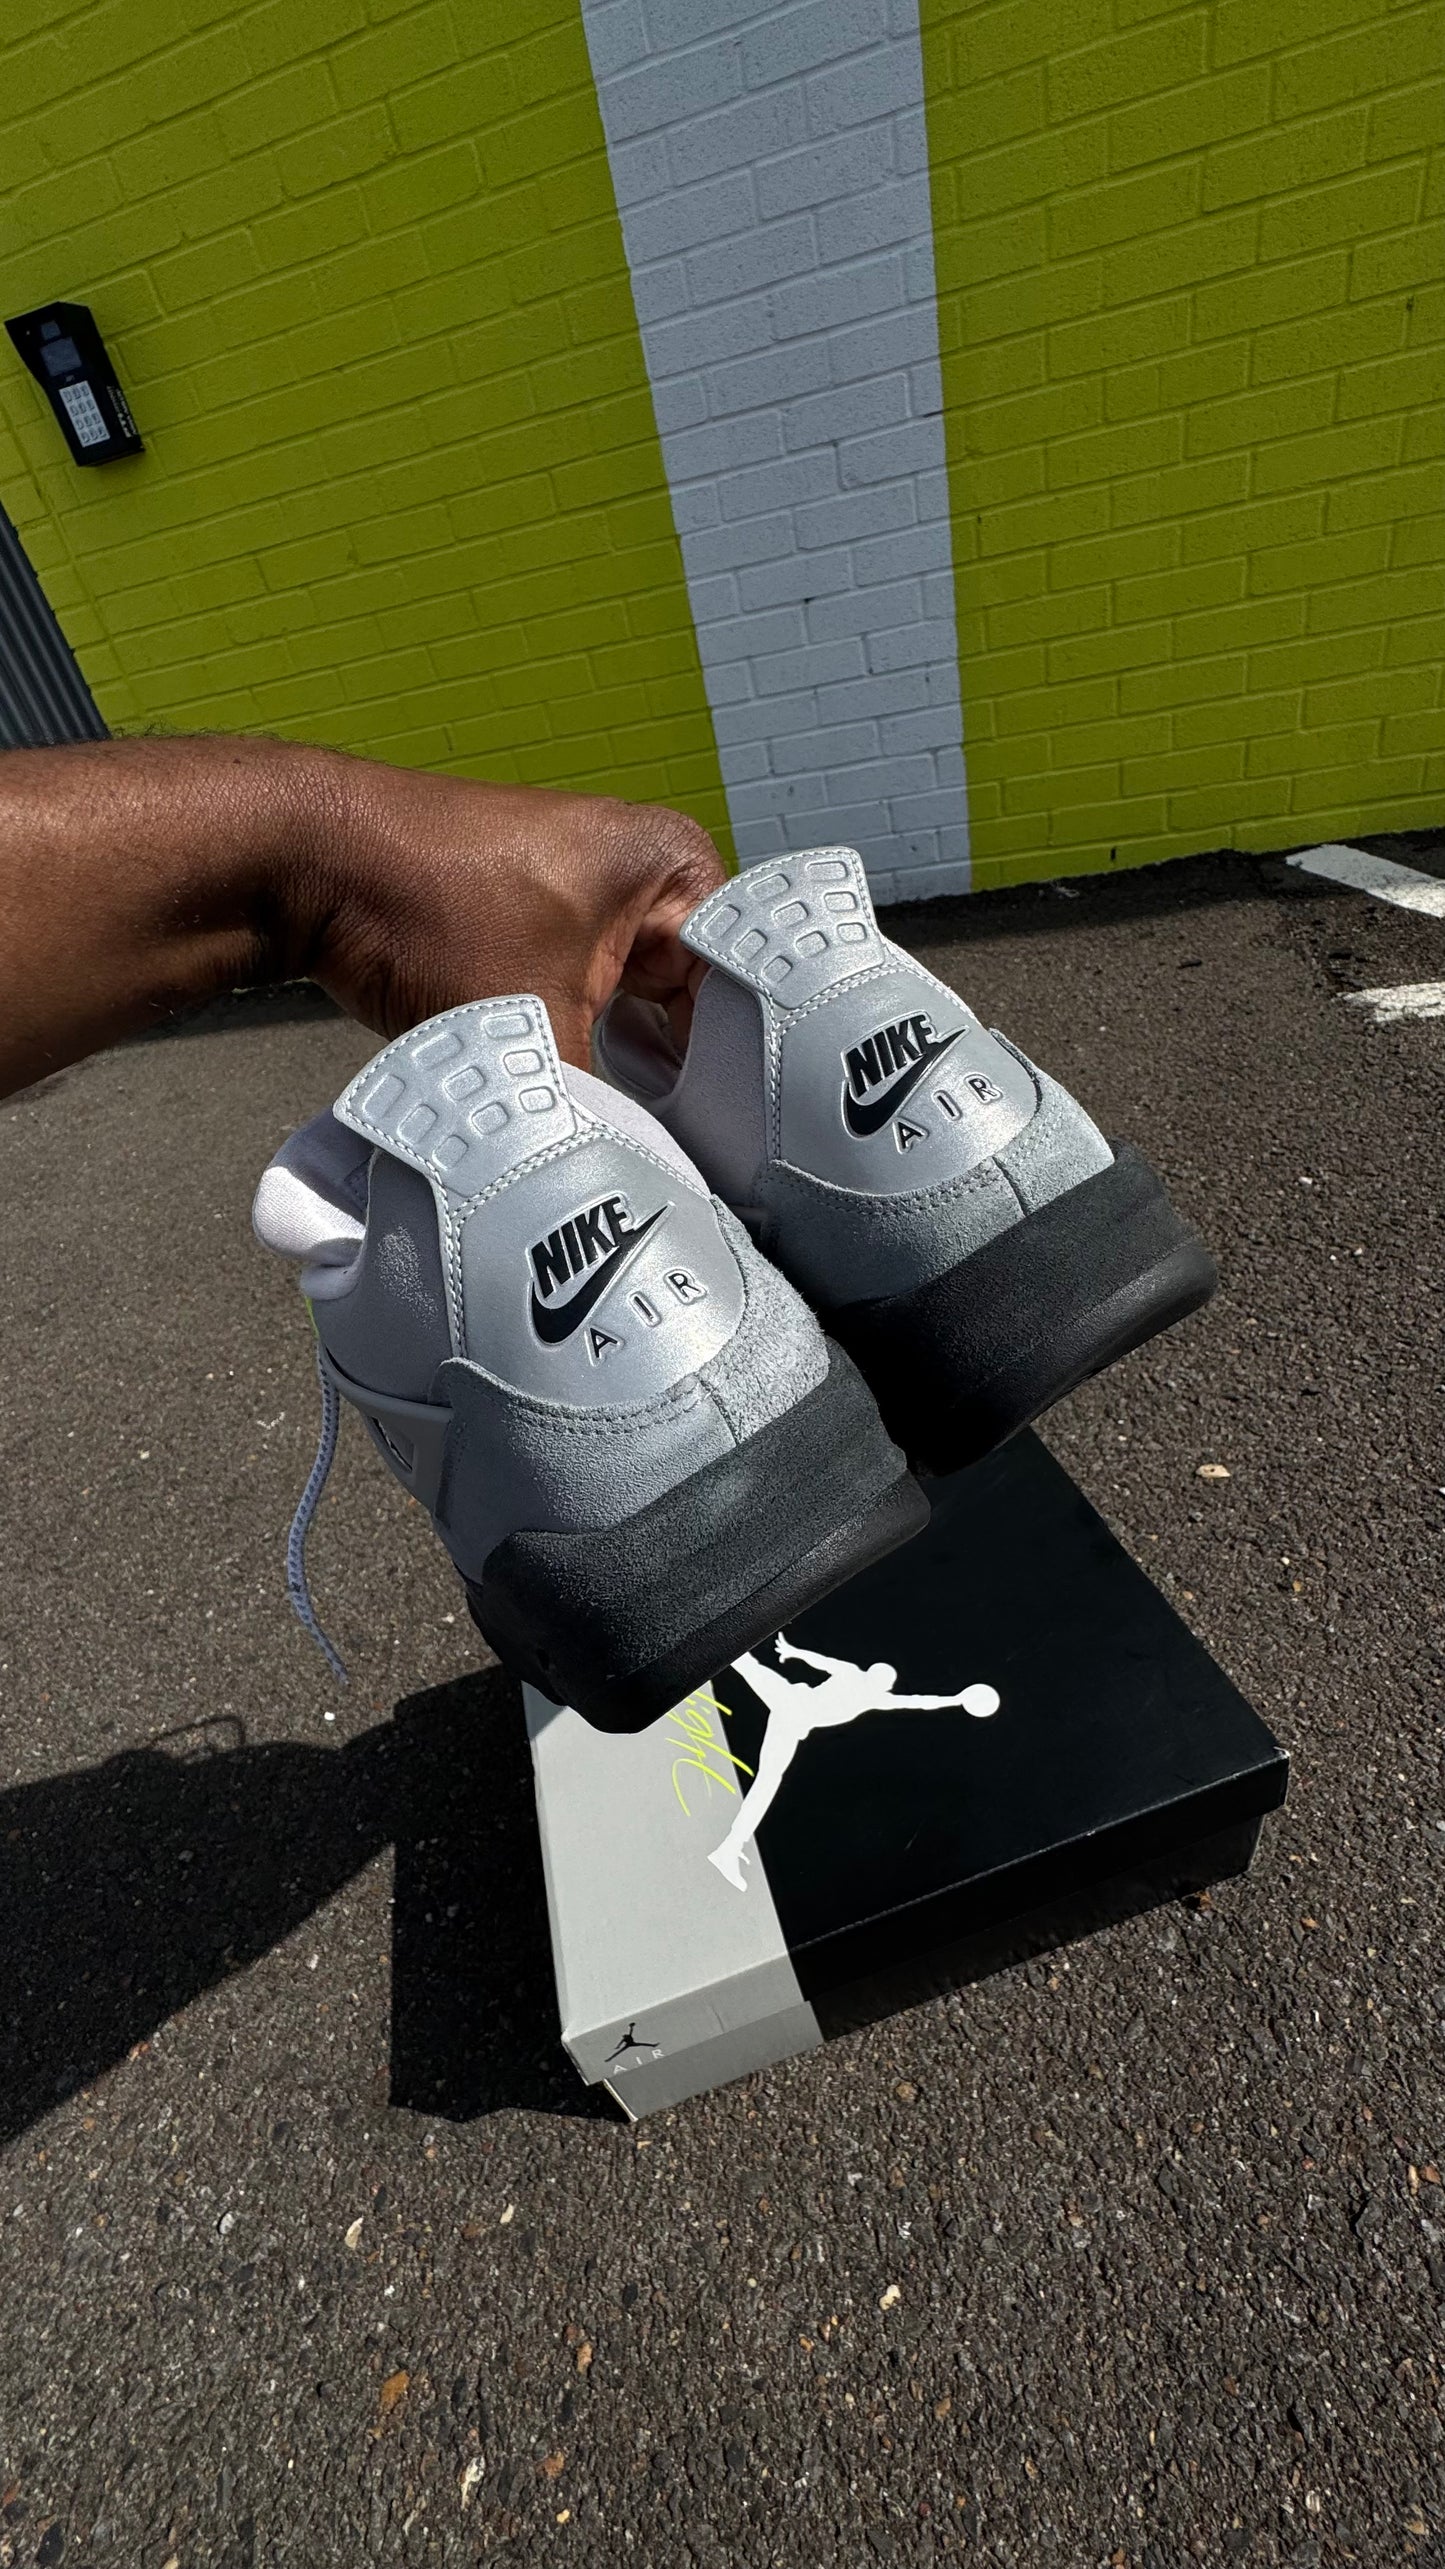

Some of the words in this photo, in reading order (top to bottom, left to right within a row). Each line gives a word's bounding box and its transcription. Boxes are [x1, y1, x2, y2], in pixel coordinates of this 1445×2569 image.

[845, 1013, 933, 1099] NIKE
[896, 1076, 999, 1152] AIR
[531, 1195, 635, 1299] NIKE
[587, 1271, 703, 1361] AIR
[613, 2048, 665, 2074] AIR
